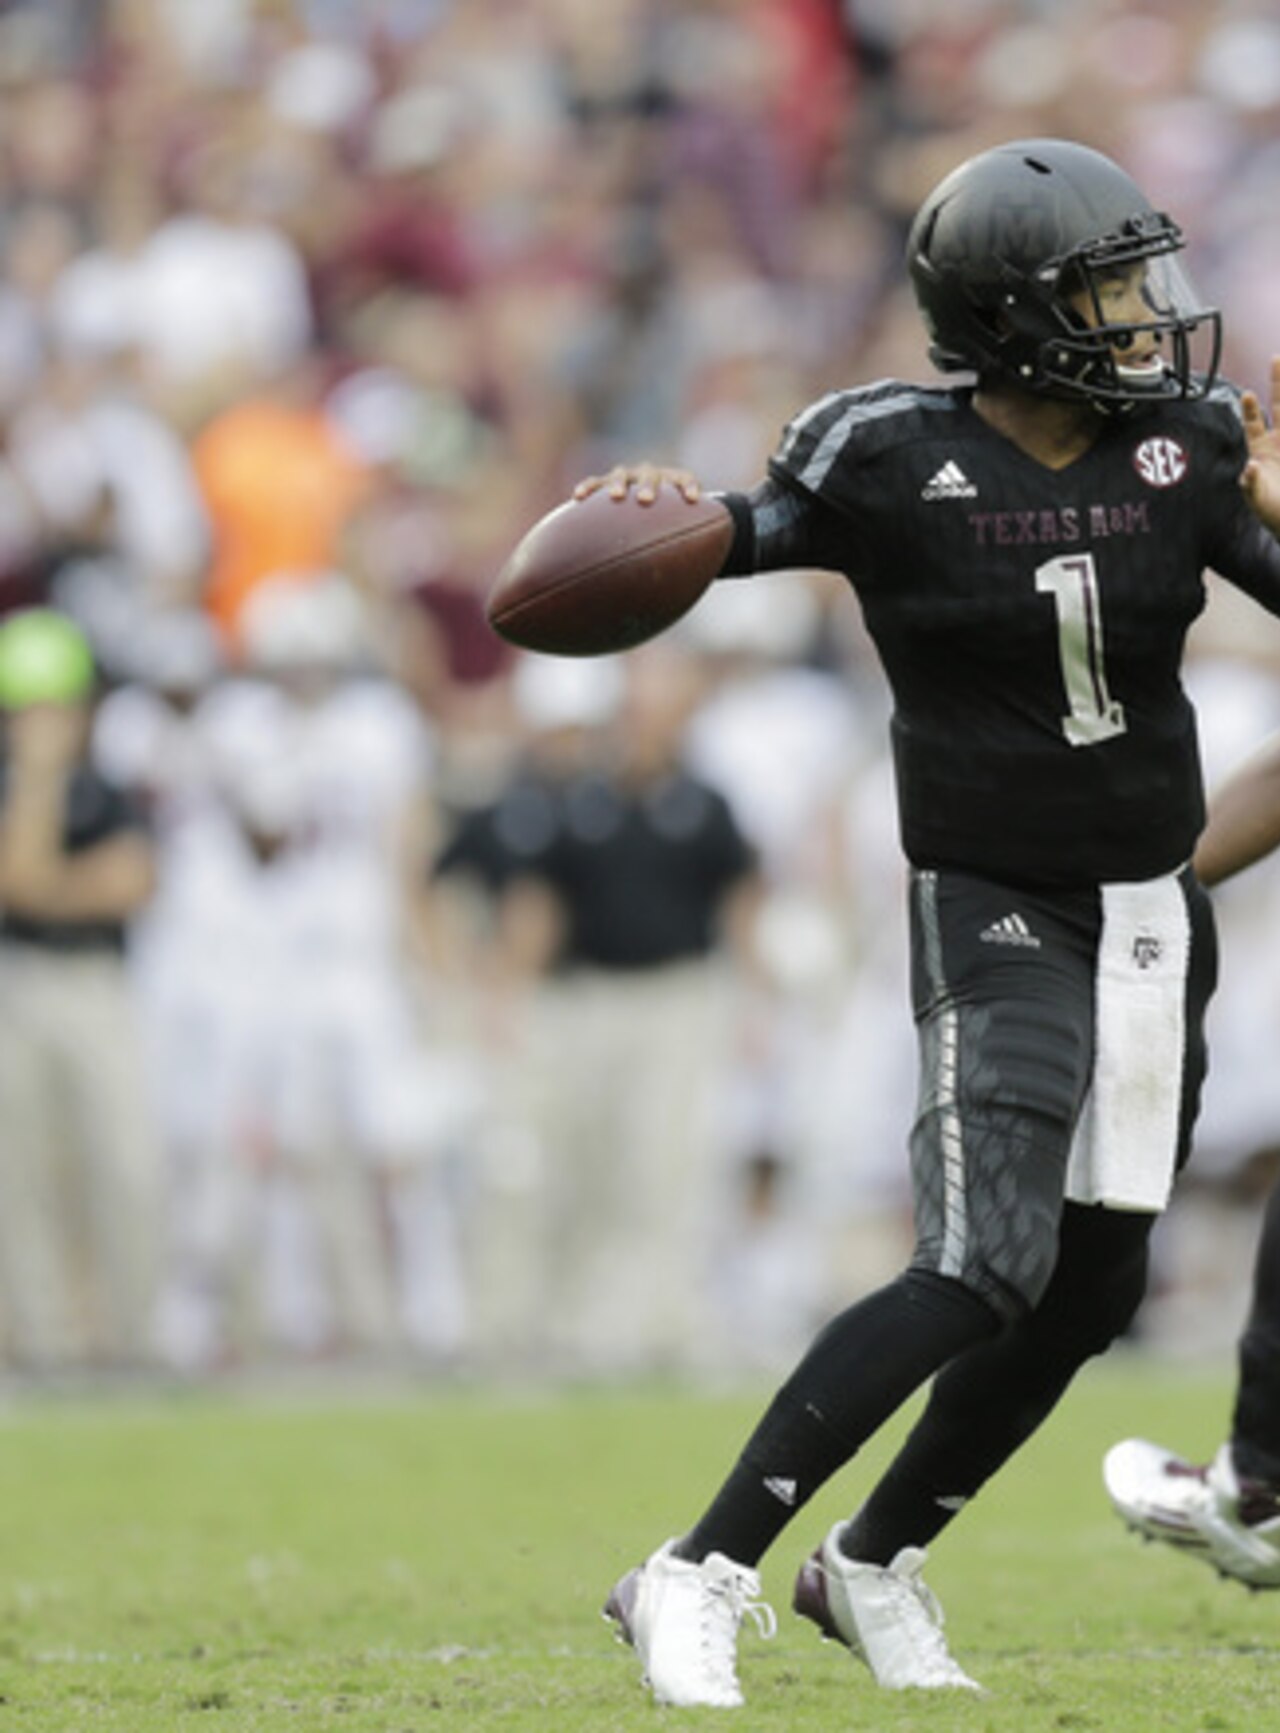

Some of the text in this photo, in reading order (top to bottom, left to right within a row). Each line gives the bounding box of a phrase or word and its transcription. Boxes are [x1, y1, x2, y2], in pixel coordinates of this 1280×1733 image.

[1136, 437, 1187, 486] SEC
[968, 501, 1151, 546] TEXAS A&M
[1034, 552, 1127, 746] 1
